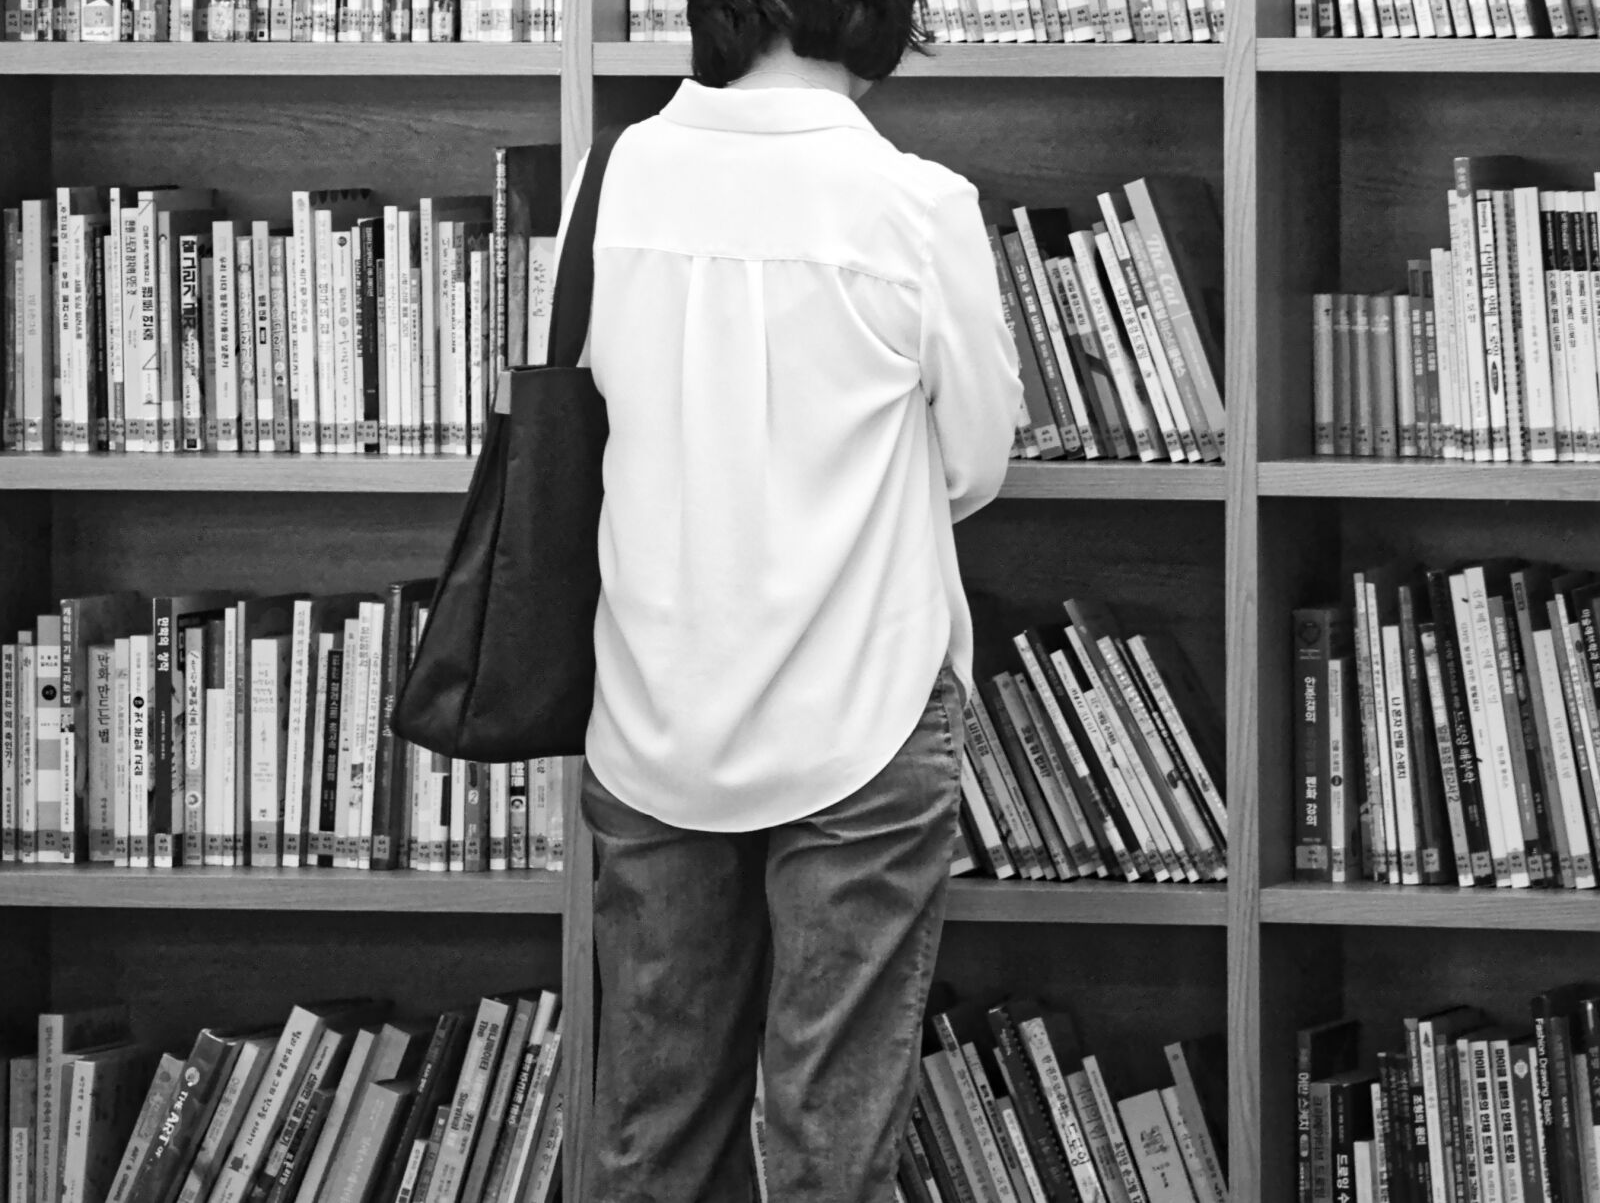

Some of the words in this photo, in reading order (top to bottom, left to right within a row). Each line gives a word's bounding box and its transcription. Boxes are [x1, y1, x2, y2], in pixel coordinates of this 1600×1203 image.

[1144, 233, 1169, 272] The
[1157, 271, 1181, 308] Cat
[157, 617, 168, 646] 만화의
[157, 652, 168, 671] 창작
[1391, 695, 1401, 706] 나
[1391, 708, 1402, 727] 혼자
[1394, 750, 1406, 779] 스케치
[1534, 1017, 1547, 1056] Fashion
[1297, 1072, 1309, 1094] 어반
[1537, 1057, 1551, 1098] Drawing
[173, 1089, 189, 1111] THE
[450, 1091, 469, 1131] Survival
[1297, 1097, 1309, 1130] 스케치
[1411, 1094, 1425, 1123] 조형의
[1542, 1098, 1553, 1125] Basic
[155, 1110, 181, 1147] ART
[1335, 1153, 1349, 1188] 드로잉
